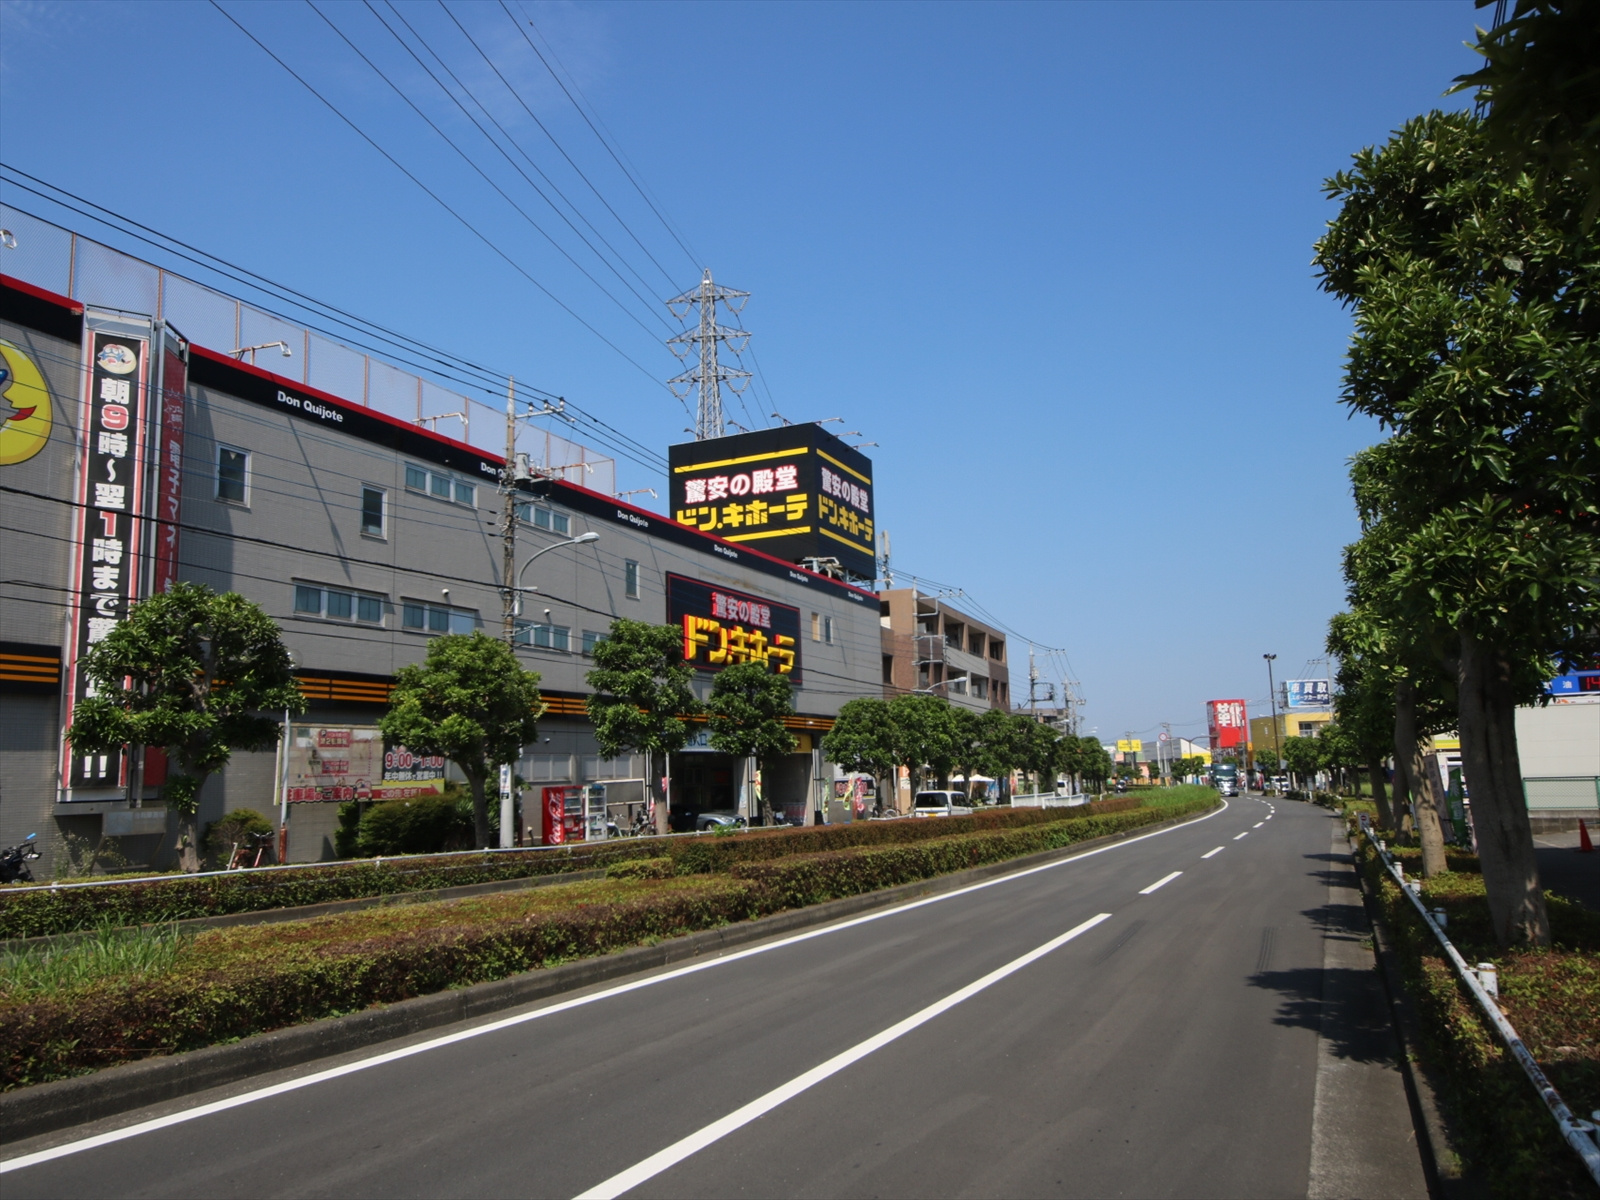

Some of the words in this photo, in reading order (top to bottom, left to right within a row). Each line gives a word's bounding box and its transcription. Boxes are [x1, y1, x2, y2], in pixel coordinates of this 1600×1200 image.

[277, 390, 301, 408] Don
[303, 400, 344, 423] Quijote
[480, 462, 496, 475] Don
[685, 464, 798, 504] 驚安の殿堂
[821, 467, 869, 513] 驚安の殿堂
[617, 509, 629, 521] Don
[629, 514, 649, 528] Quijote
[714, 543, 723, 553] Don
[723, 547, 738, 559] Quijote
[712, 592, 771, 628] 驚安の殿堂
[548, 790, 562, 845] Coca-Cola
